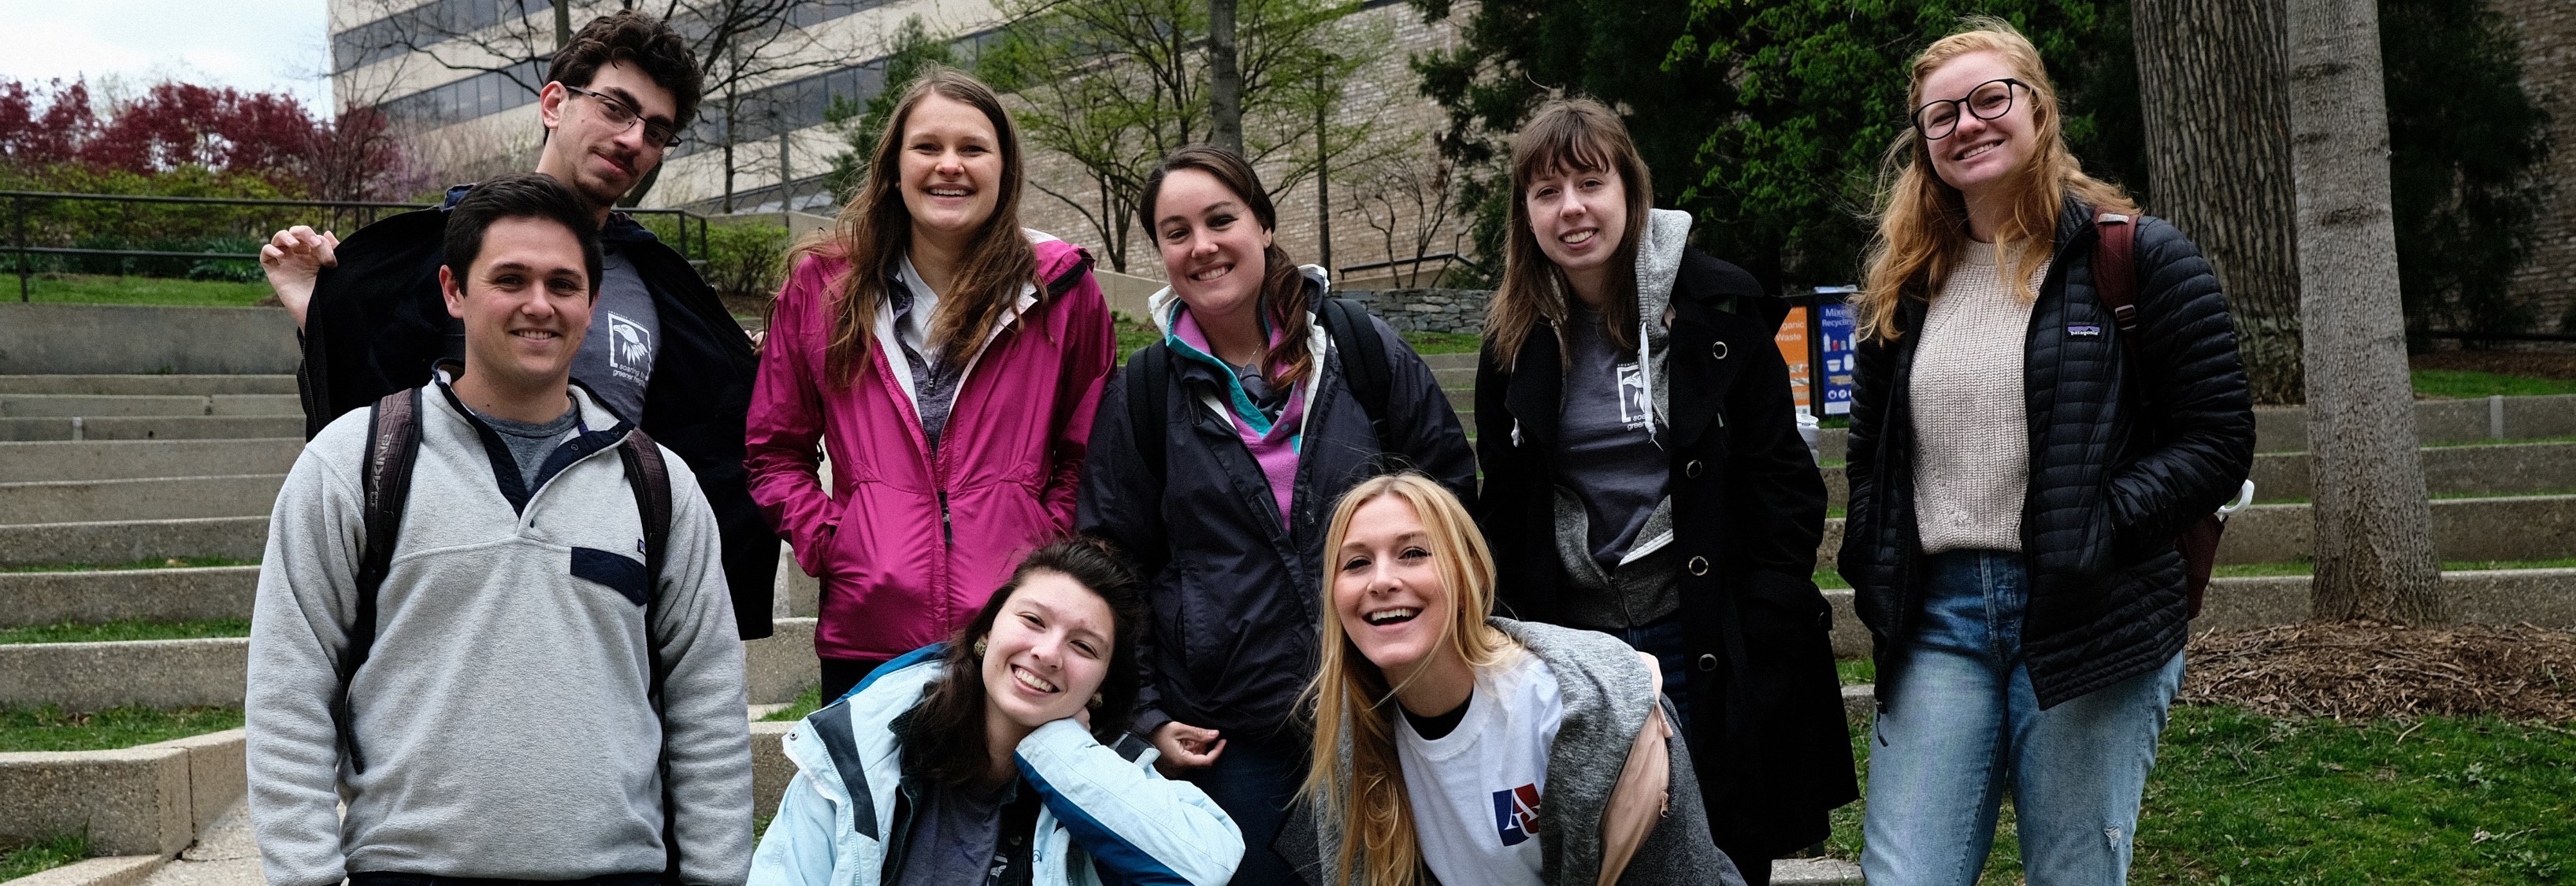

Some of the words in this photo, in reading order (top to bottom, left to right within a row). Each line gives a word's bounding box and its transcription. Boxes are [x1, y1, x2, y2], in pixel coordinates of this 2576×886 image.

[1825, 308, 1854, 317] Mixed
[1782, 321, 1805, 331] ganic
[1821, 318, 1857, 328] Recycling
[1776, 333, 1802, 342] Waste
[612, 369, 634, 380] greener
[618, 364, 640, 377] soaring
